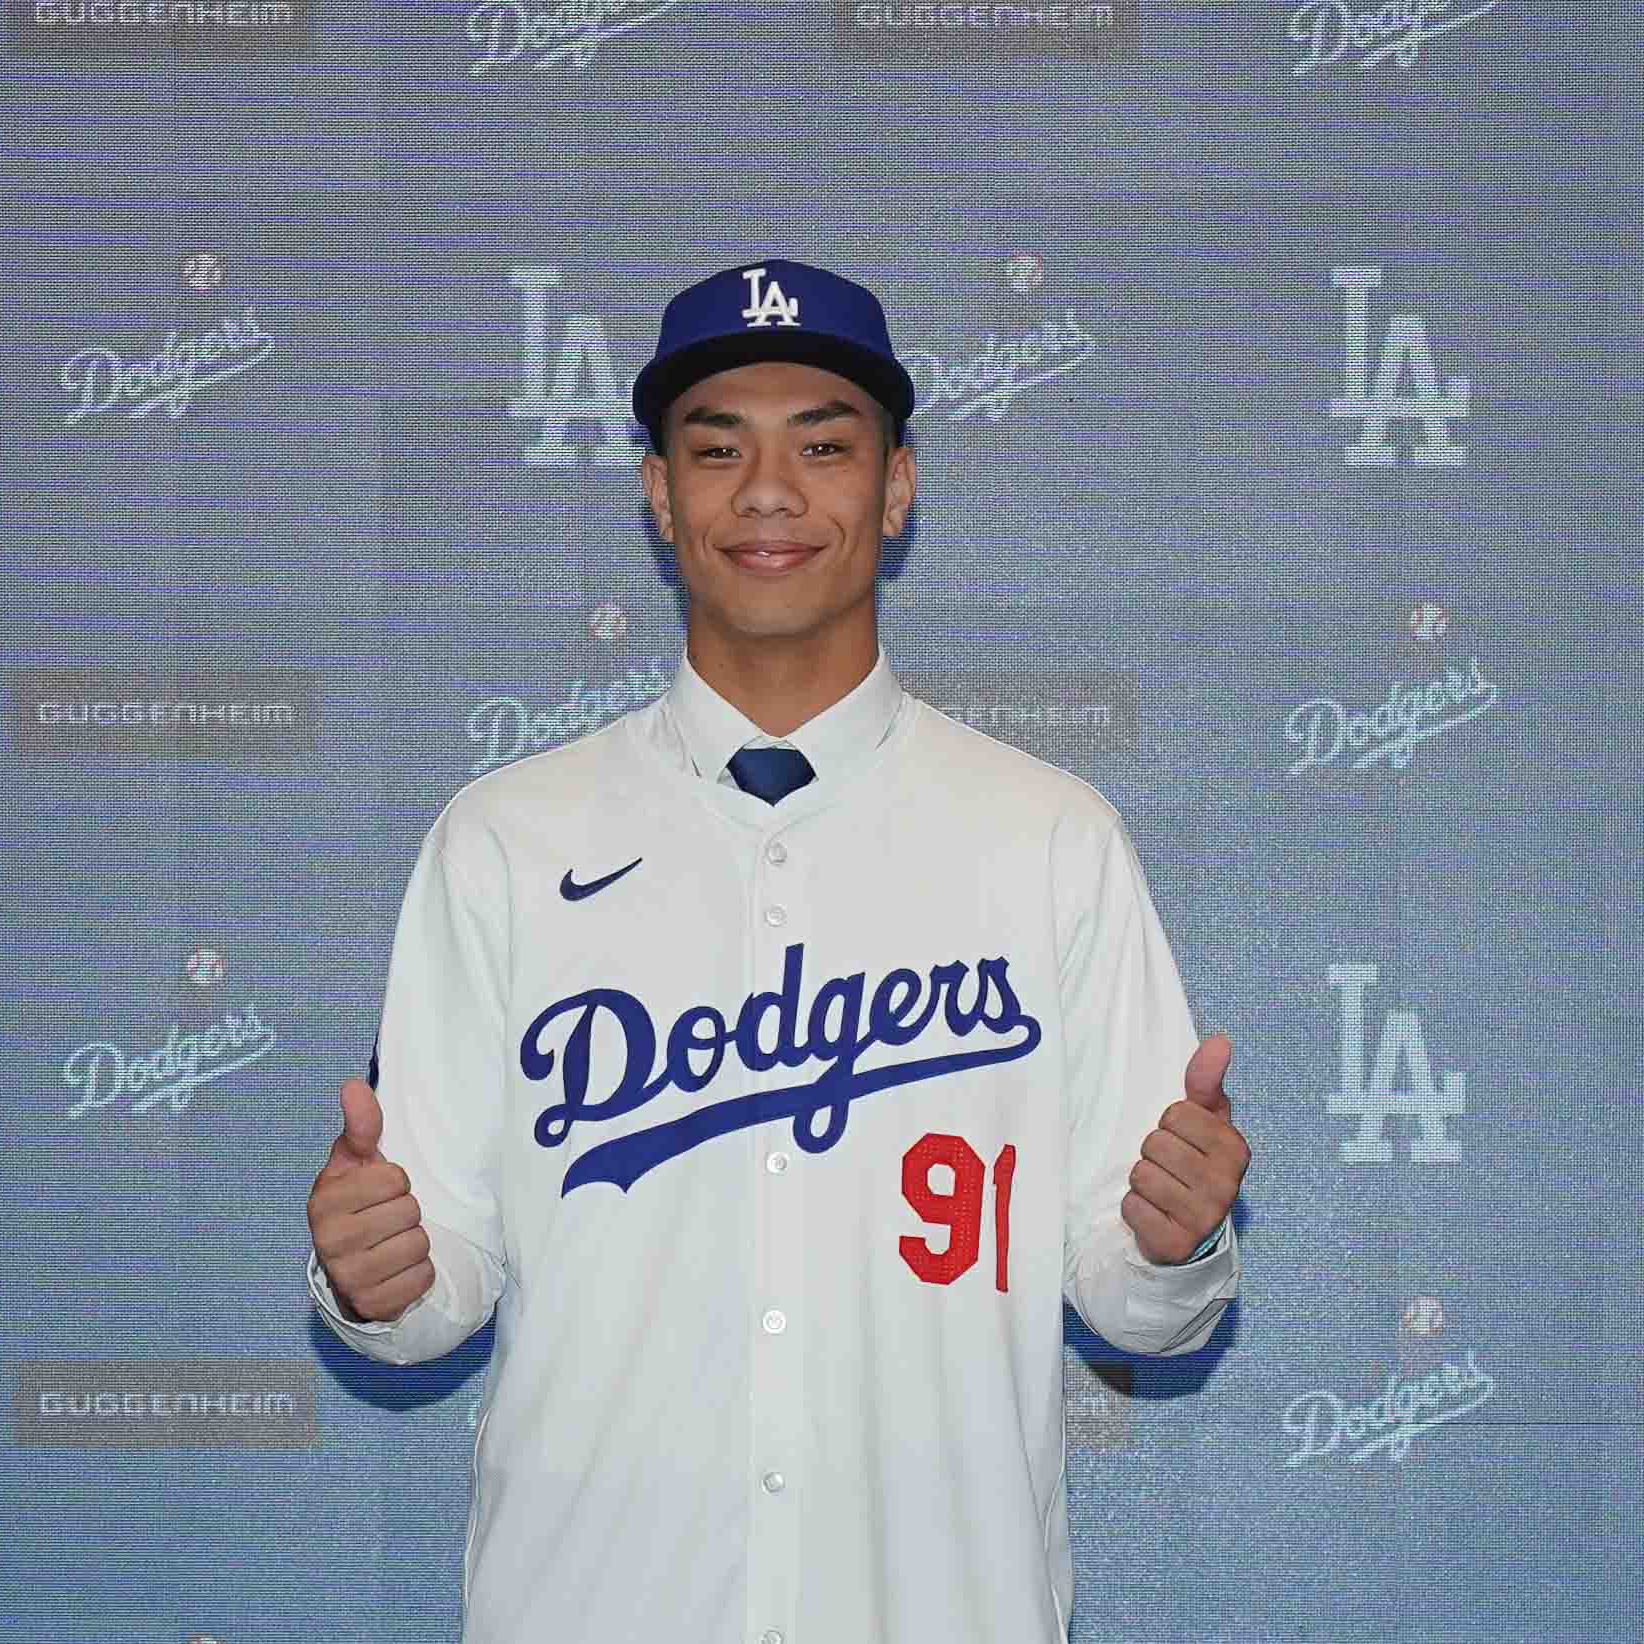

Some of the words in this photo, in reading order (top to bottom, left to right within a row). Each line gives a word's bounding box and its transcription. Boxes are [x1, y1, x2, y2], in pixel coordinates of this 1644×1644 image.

[855, 3, 1114, 28] GUGGENHEIM
[742, 267, 801, 327] LA
[61, 303, 274, 423] Dodgers
[1331, 267, 1469, 466] LA
[38, 702, 292, 724] GUGGENHEIM
[1287, 657, 1498, 773] Dodgers
[63, 1001, 275, 1119] Dodgers
[520, 942, 1042, 1199] Dodgers
[1328, 963, 1465, 1162] LA
[899, 1132, 1017, 1293] 91
[39, 1392, 296, 1416] GUGGENHEIM
[1281, 1349, 1494, 1467] Dodgers
